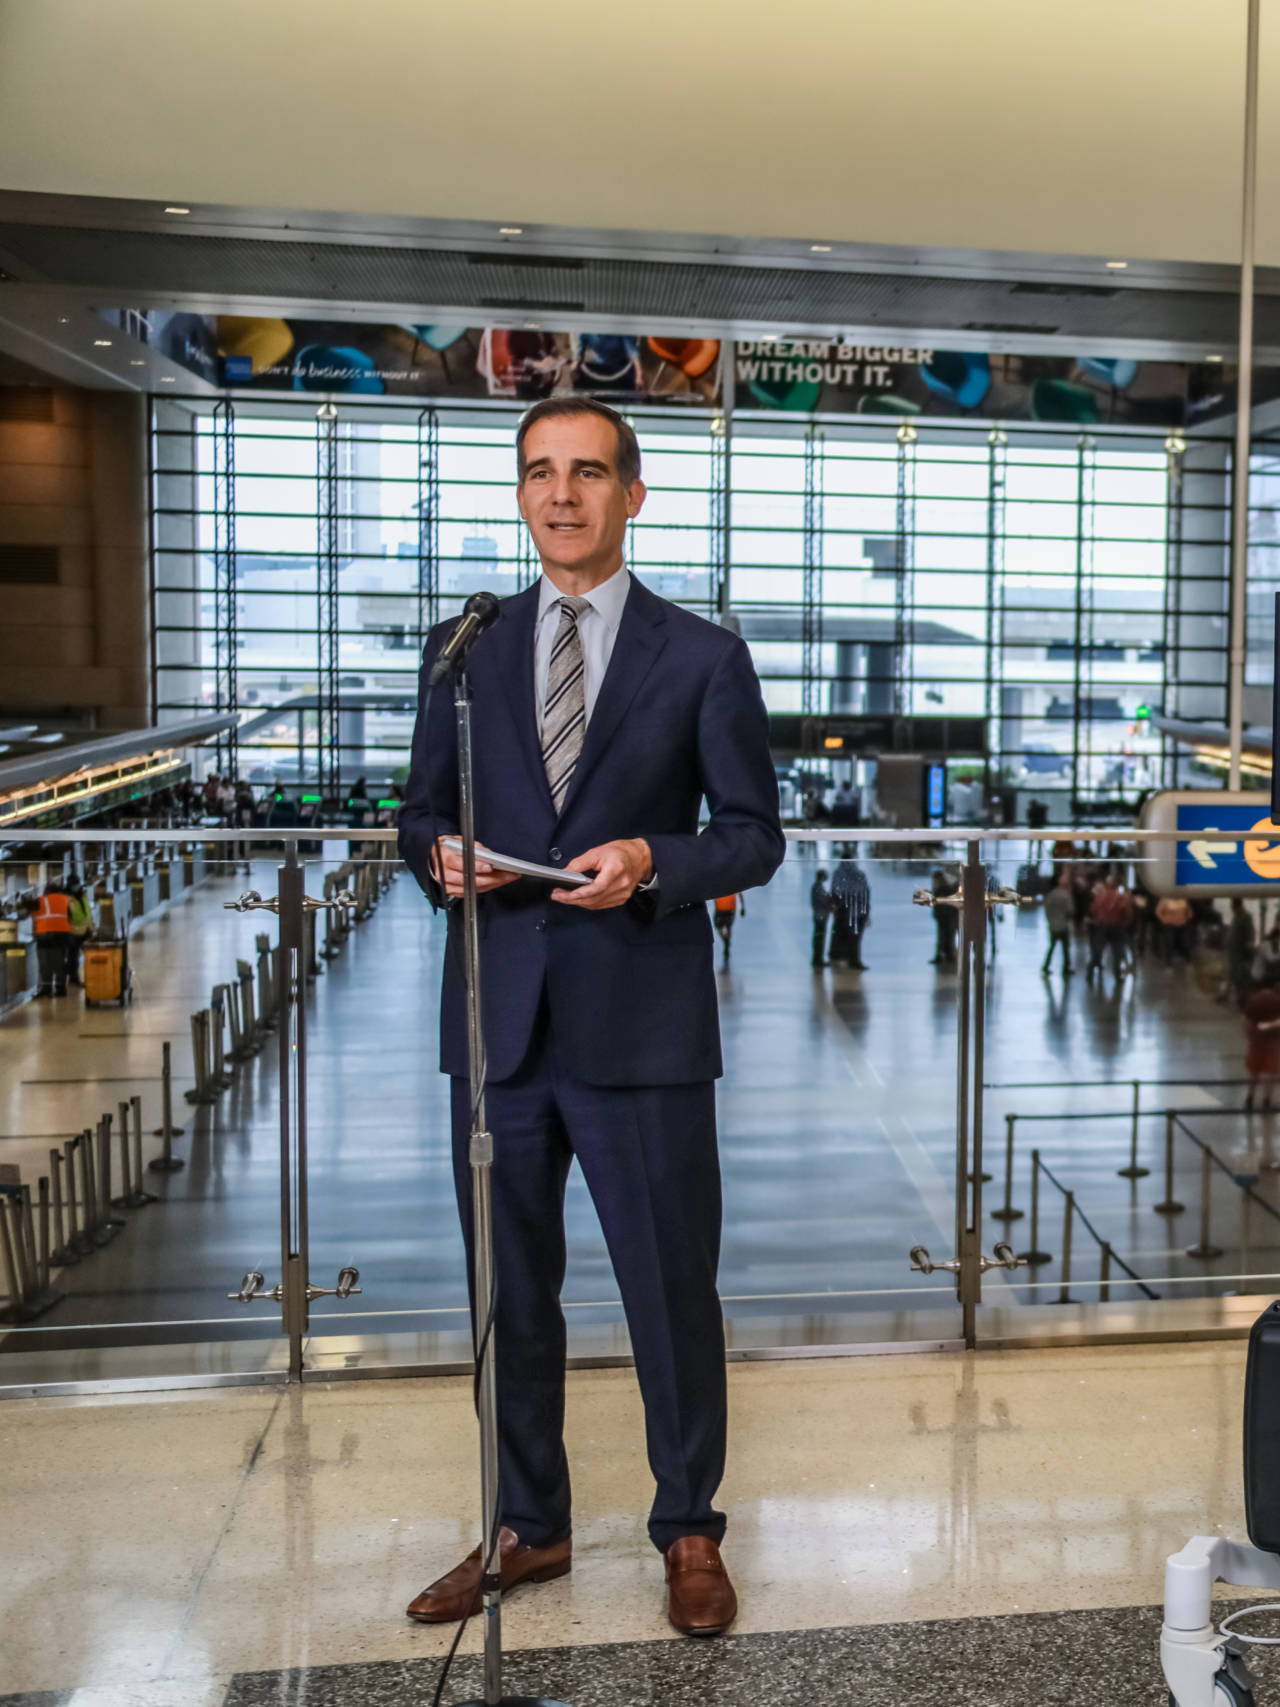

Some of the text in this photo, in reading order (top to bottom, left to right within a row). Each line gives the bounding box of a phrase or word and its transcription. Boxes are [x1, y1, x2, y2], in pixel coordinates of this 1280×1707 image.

[737, 341, 934, 365] DREAM BIGGER
[737, 360, 893, 387] WITHOUT IT.
